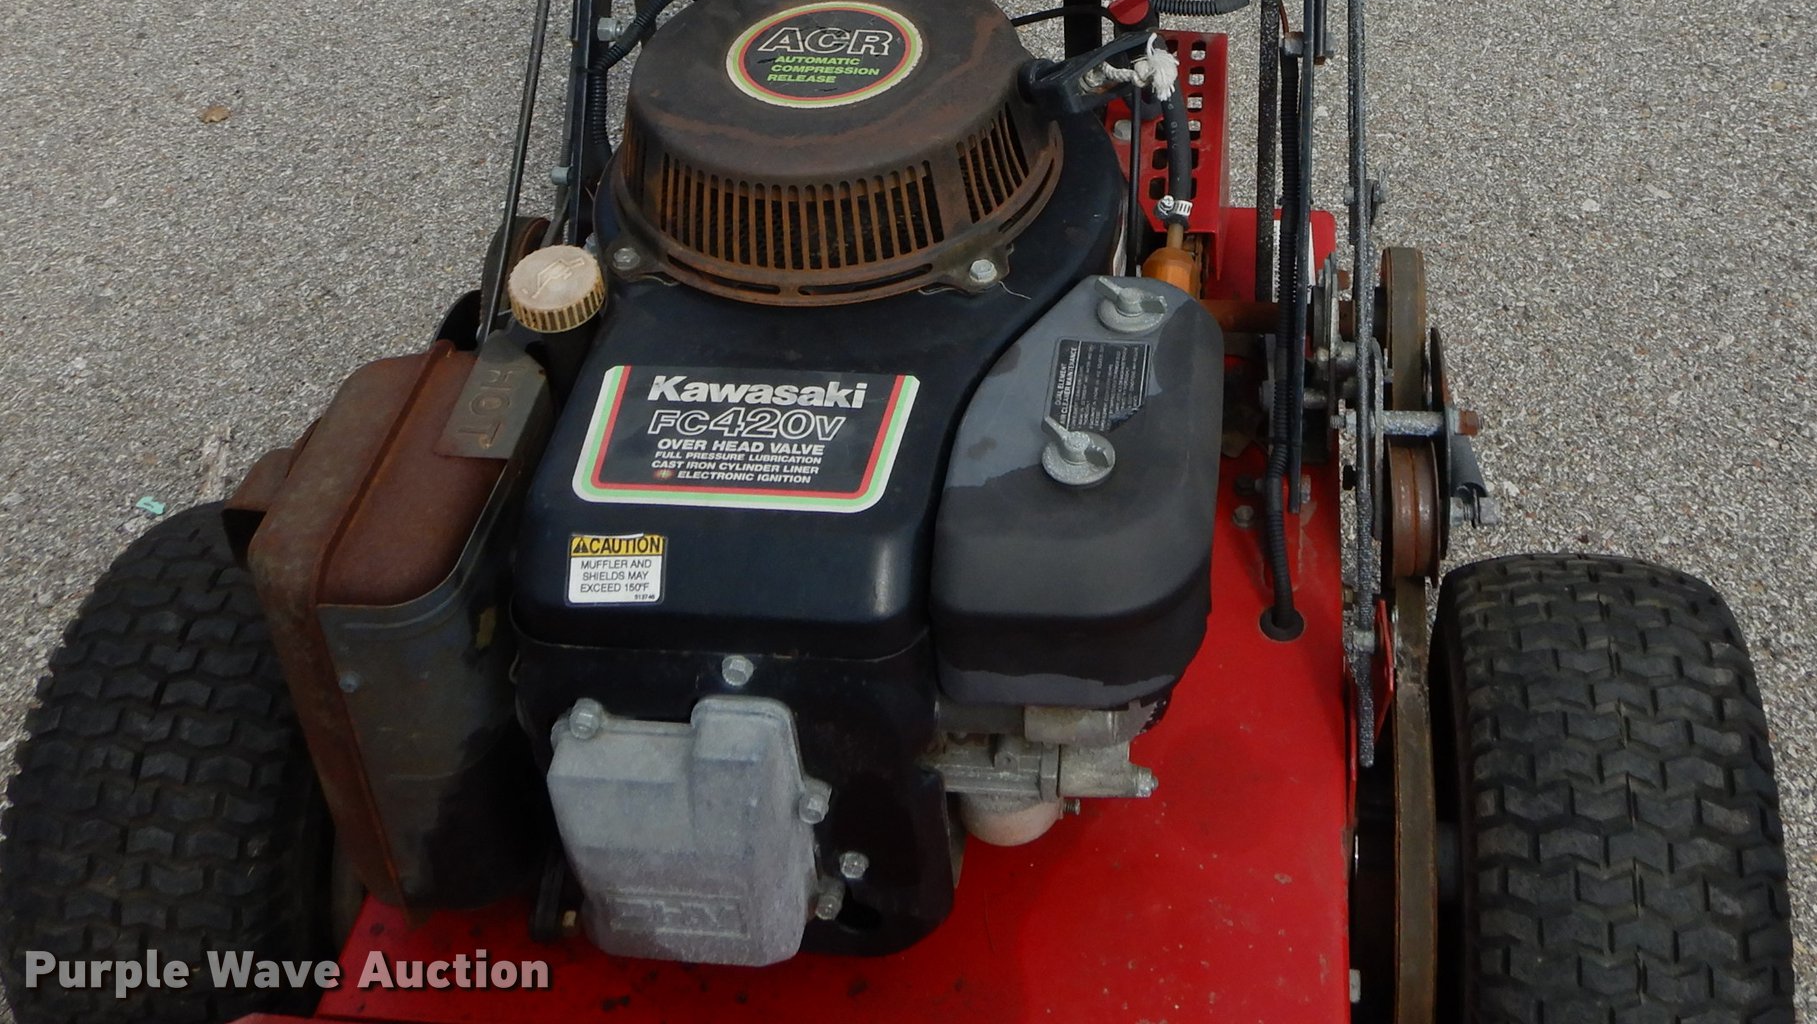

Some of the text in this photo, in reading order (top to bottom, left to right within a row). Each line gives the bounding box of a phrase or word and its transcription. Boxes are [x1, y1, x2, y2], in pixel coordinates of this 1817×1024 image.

[758, 27, 893, 56] ACR
[775, 56, 860, 65] AUTOMATIC
[771, 64, 880, 76] COMPRESSION
[766, 73, 836, 83] RELEASE
[1065, 347, 1078, 386] MAINTENANCE
[648, 375, 868, 409] Kawasaki
[648, 407, 846, 441] FC420V
[657, 438, 825, 456] OVER HEAD VALVE
[655, 451, 822, 464] FULL PRESSURE LUBRICATION
[651, 460, 819, 474] CAST IRON CYLINDER LINER
[677, 470, 811, 483] ELECTRONIC IGNITION
[589, 537, 660, 553] CAUTION
[581, 559, 652, 569] MUFFLER AND
[582, 571, 649, 581] SHIELDS MAY
[580, 582, 650, 592] EXCEED 150°F
